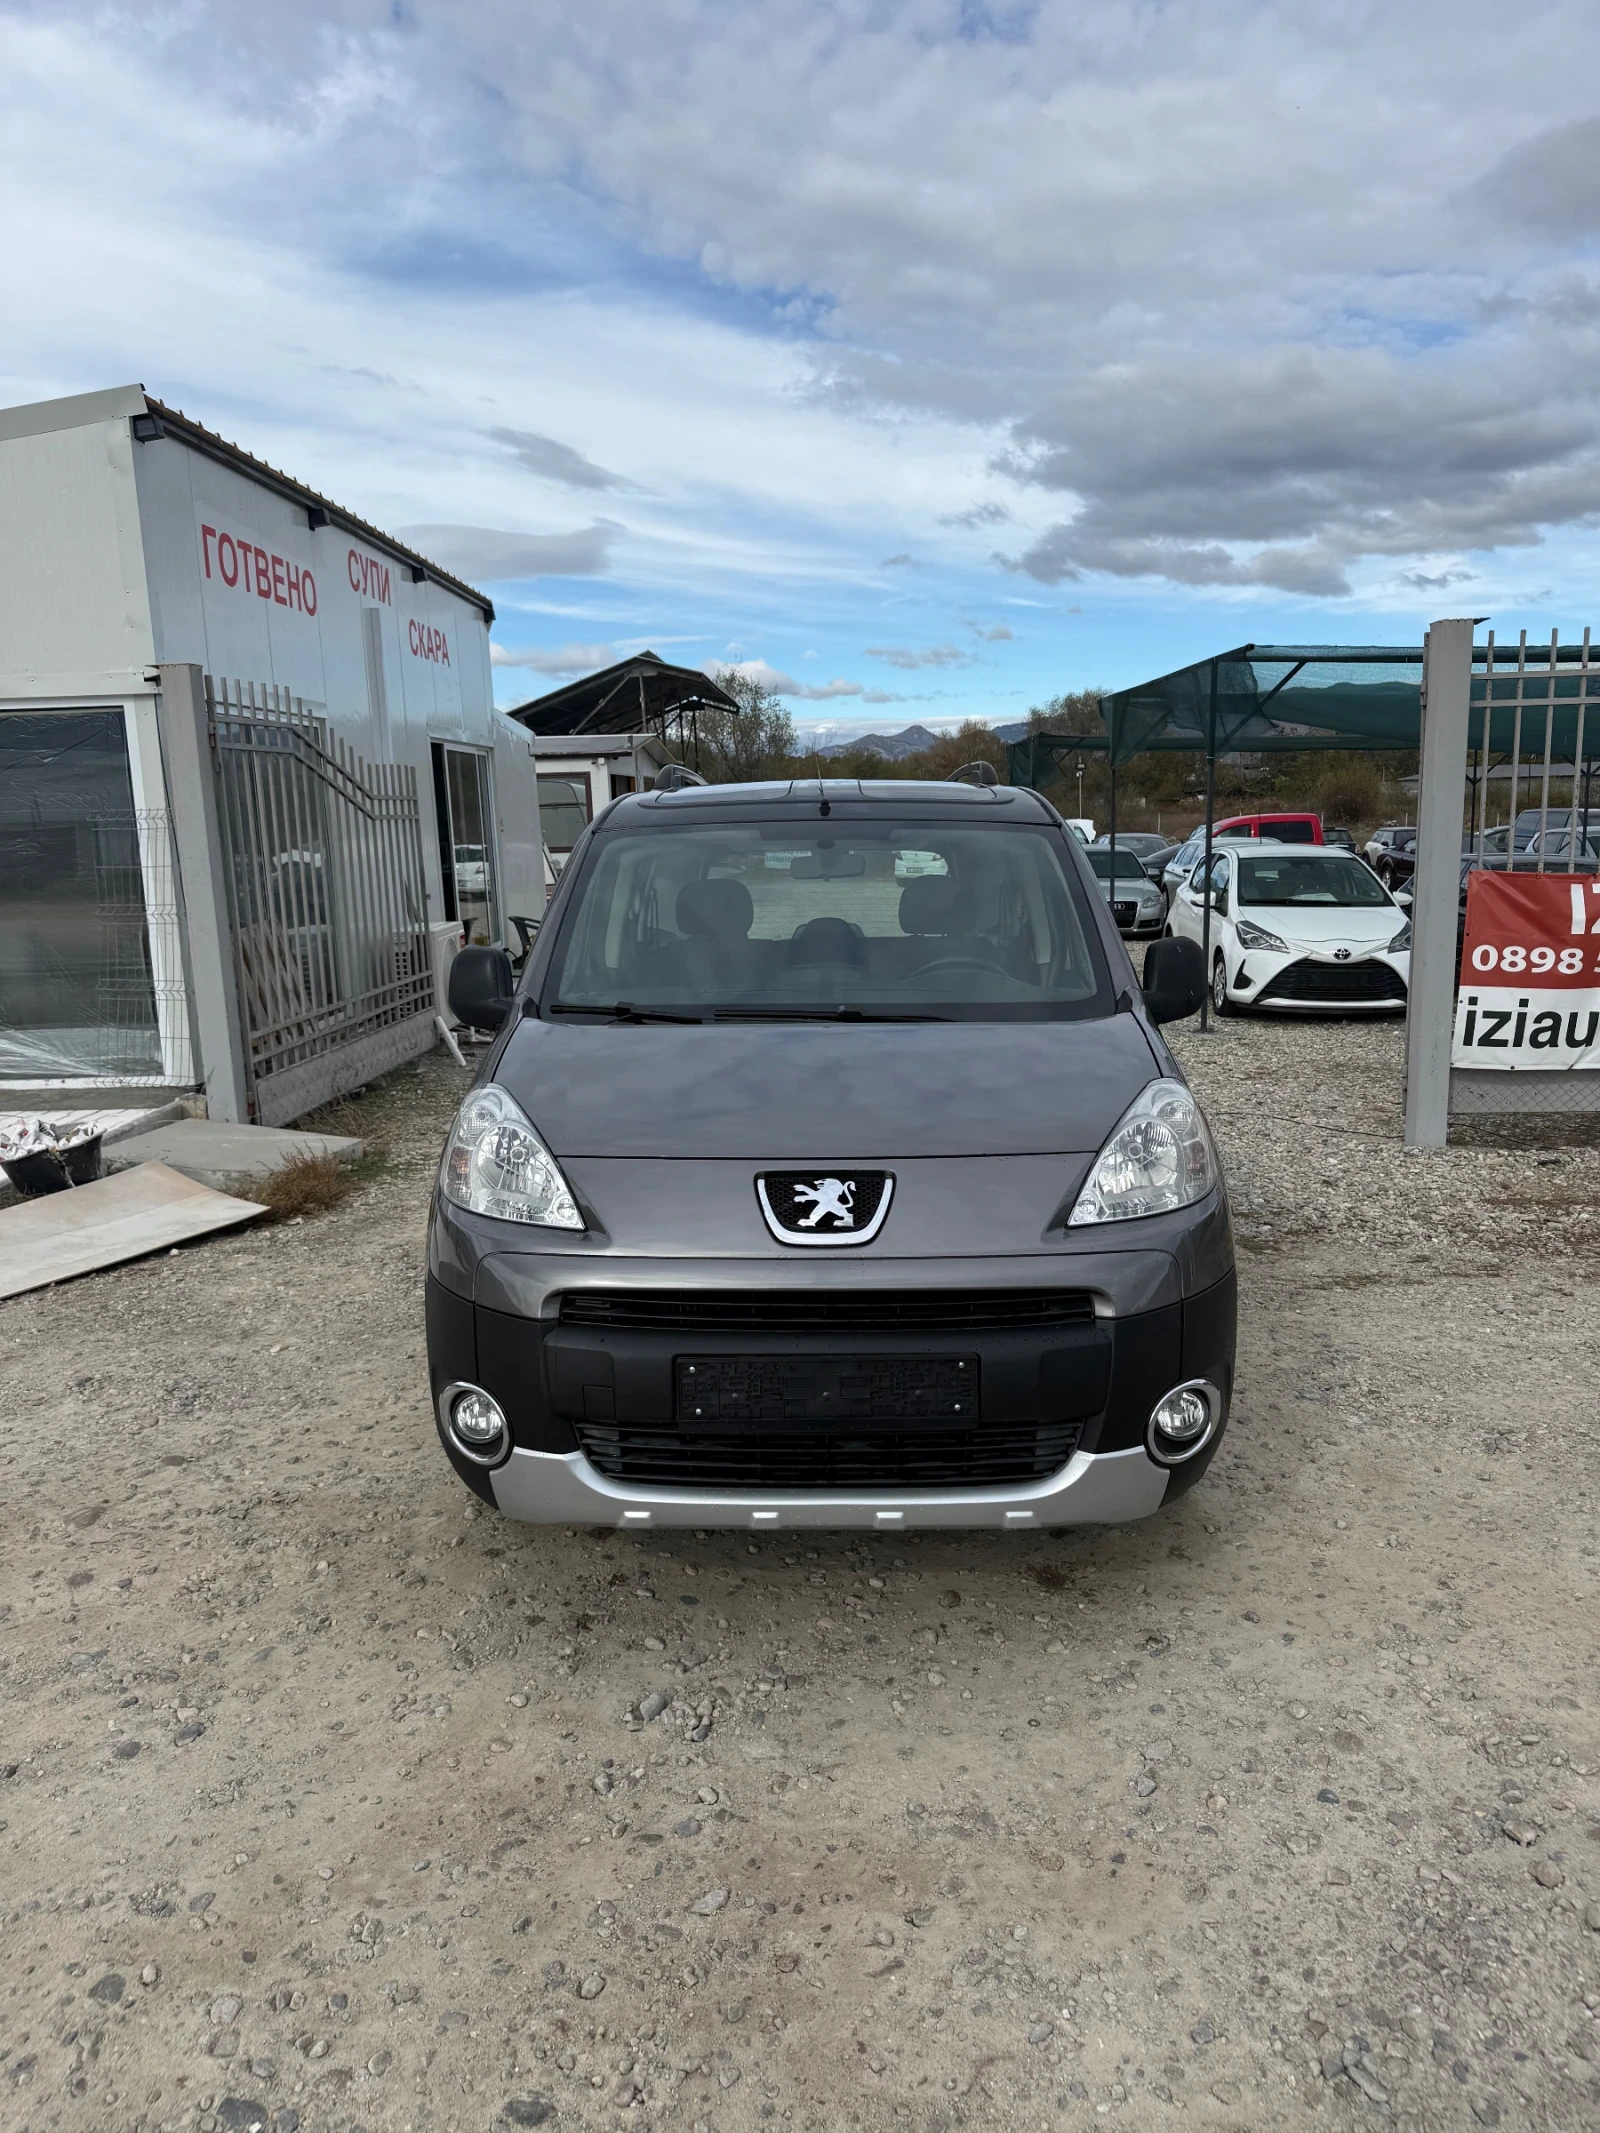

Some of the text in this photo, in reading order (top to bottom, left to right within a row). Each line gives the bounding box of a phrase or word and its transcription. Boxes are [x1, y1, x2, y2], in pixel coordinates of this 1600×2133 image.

[201, 523, 317, 617] ГОТВЕНО
[347, 548, 392, 607] СУПИ
[408, 618, 451, 668] СКАРА
[1570, 882, 1600, 936] I
[1471, 944, 1584, 975] 0898
[1462, 996, 1600, 1050] iziau
